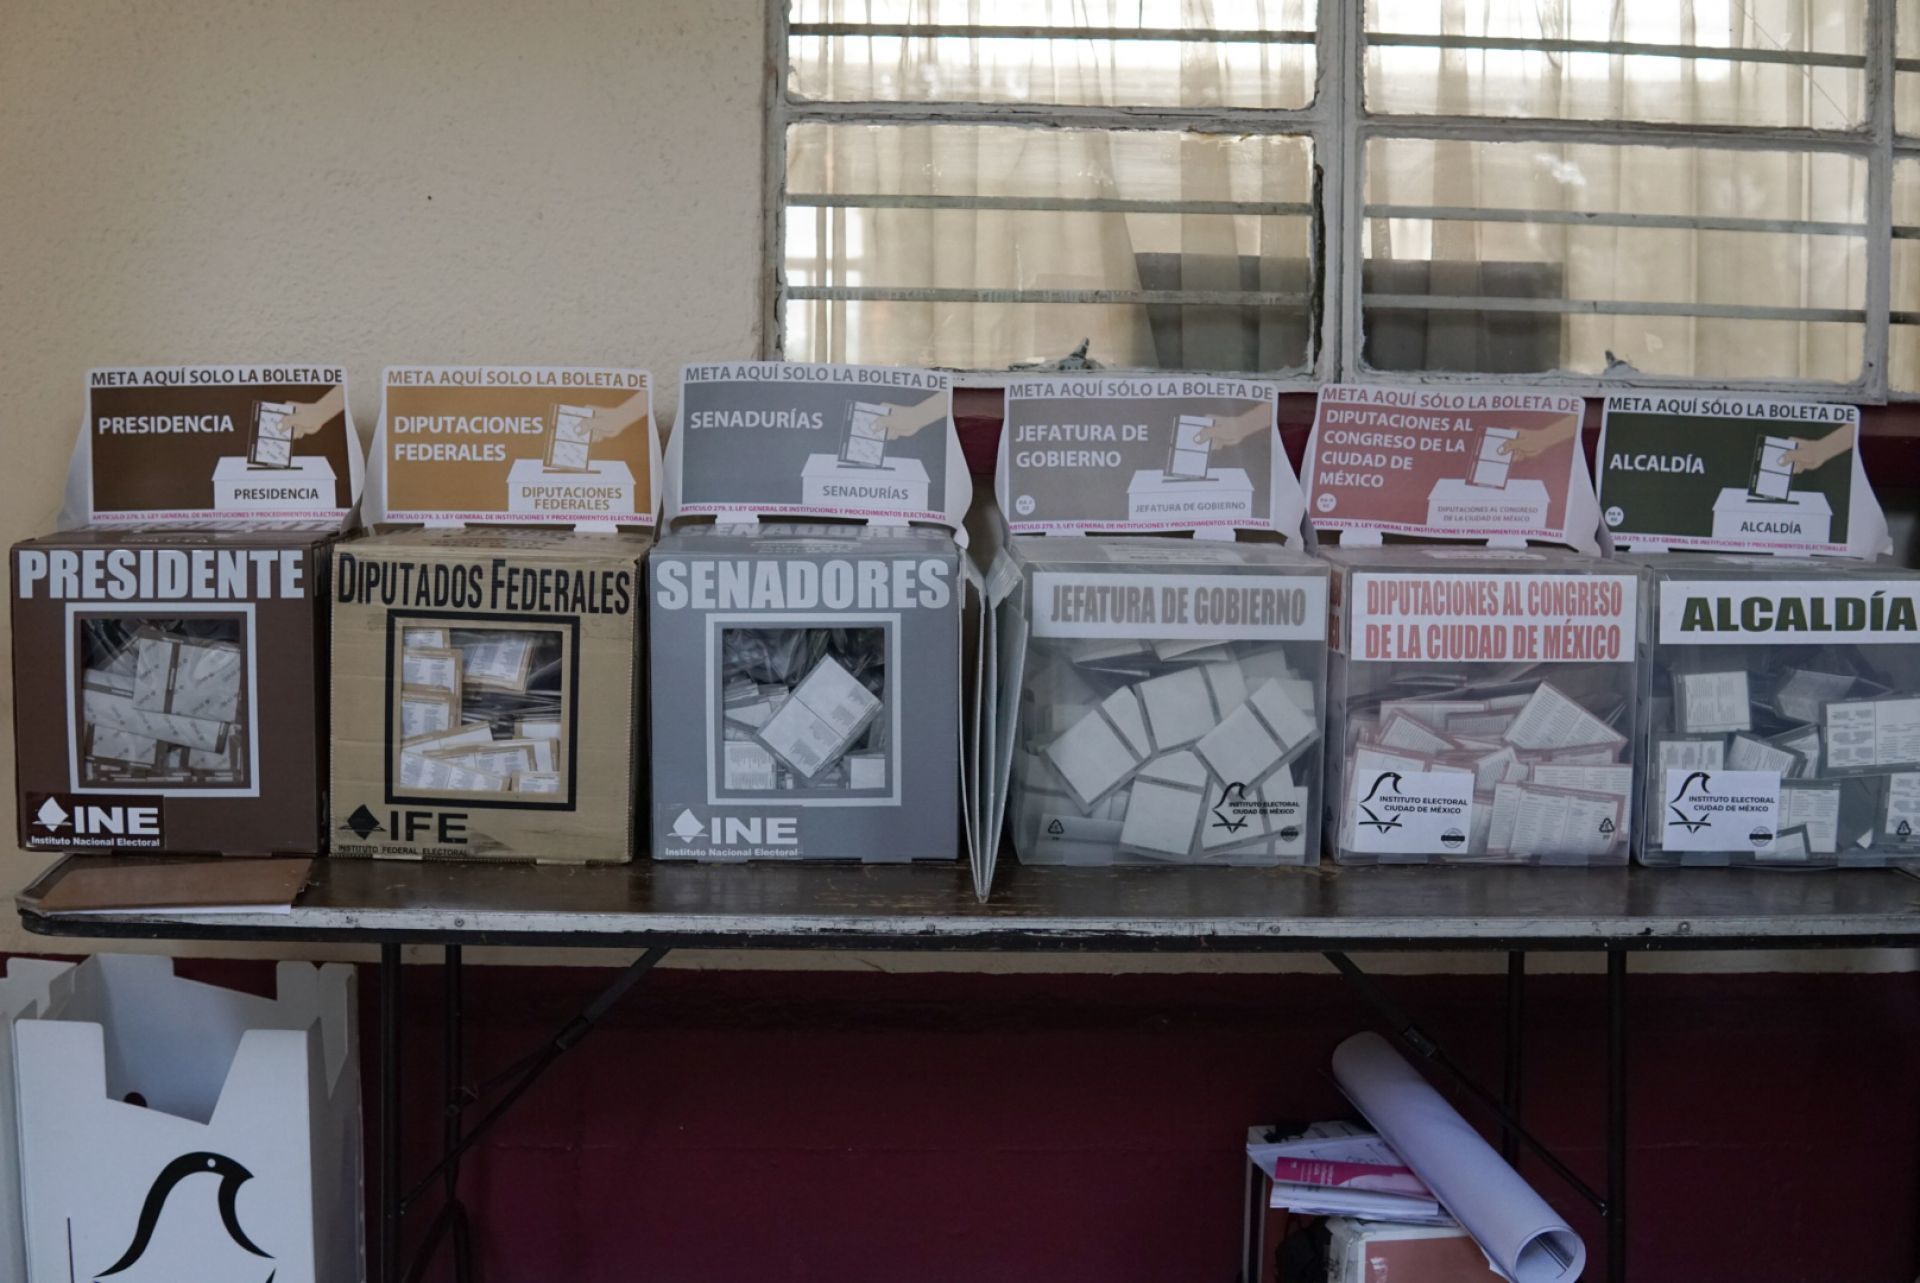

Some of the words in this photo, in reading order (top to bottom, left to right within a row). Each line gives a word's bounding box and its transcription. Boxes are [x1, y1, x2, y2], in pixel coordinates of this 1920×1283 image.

[91, 371, 138, 386] META
[143, 368, 186, 386] AQUÍ
[190, 369, 234, 384] SOLO
[239, 369, 258, 383] LA
[263, 368, 320, 382] BOLETA
[324, 368, 342, 382] DE
[388, 370, 435, 384] META
[439, 368, 483, 386] AQUÍ
[486, 371, 532, 385] SOLO
[536, 372, 557, 386] LA
[562, 372, 624, 387] BOLETA
[627, 374, 648, 388] DE
[686, 366, 731, 382] META
[735, 364, 779, 382] AQUÍ
[783, 366, 828, 382] SOLO
[833, 368, 853, 383] LA
[858, 369, 923, 387] BOLETA
[926, 375, 948, 389] DE
[1009, 384, 1055, 398] META
[1060, 380, 1102, 398] AQUÍ
[1108, 380, 1152, 397] SÓLO
[1157, 382, 1178, 396] LA
[1182, 382, 1247, 398] BOLETA
[1252, 386, 1272, 400] DE
[1322, 387, 1368, 402] META
[1373, 389, 1417, 406] AQUÍ
[1420, 390, 1464, 409] SÓLO
[1468, 395, 1487, 409] LA
[1492, 394, 1552, 410] BOLETA
[1558, 398, 1579, 412] DE
[1608, 397, 1651, 411] META
[1656, 398, 1697, 415] AQUÍ
[1701, 400, 1743, 416] SÓLO
[1747, 403, 1764, 417] LA
[1769, 404, 1829, 420] BOLETA
[1834, 408, 1854, 422] DE
[98, 415, 234, 435] PRESIDENCIA
[394, 416, 544, 434] DIPUTACIONES
[690, 408, 824, 430] SENADURÍAS
[1326, 410, 1450, 431] DIPUTACIONES
[1453, 418, 1474, 432] AL
[1016, 424, 1117, 442] JEFATURA
[1122, 425, 1148, 441] DE
[1323, 430, 1416, 450] CONGRESO
[1420, 437, 1441, 452] DE
[1445, 438, 1466, 452] LA
[394, 444, 506, 462] FEDERALES
[1016, 451, 1122, 468] GOBIERNO
[1320, 451, 1386, 468] CIUDAD
[1390, 456, 1414, 470] DE
[1609, 453, 1704, 474] ALCALDÍA
[1318, 470, 1384, 488] MÉXICO
[234, 488, 319, 500] PRESIDENCIA
[522, 486, 622, 500] DIPUTACIONES
[822, 485, 909, 500] SENADURÍAS
[534, 499, 610, 510] FEDERALES
[1136, 503, 1181, 514] JEFATURA
[1182, 502, 1196, 512] DE
[1197, 502, 1246, 511] GOBIERNO
[1490, 506, 1499, 514] AL
[1500, 506, 1538, 514] CONGRESO
[1456, 514, 1465, 522] LA
[1466, 514, 1492, 522] CIUDAD
[1504, 514, 1530, 522] MÉXICO
[1740, 521, 1802, 534] ALCALDÍA
[18, 550, 304, 599] PRESIDENTE
[338, 552, 483, 609] DIPUTADOS
[490, 558, 631, 615] FEDERALES
[656, 559, 950, 610] SENADORES
[1051, 585, 1156, 624] JEFATURA
[1161, 587, 1188, 624] DE
[1194, 586, 1306, 626] GOBIERNO
[1366, 580, 1498, 616] DIPUTACIONES
[1502, 581, 1524, 616] AL
[1528, 580, 1622, 617] CONGRESO
[1680, 590, 1918, 632] ALCALDÍA
[1365, 624, 1392, 659] DE
[1396, 624, 1422, 660] LA
[1426, 624, 1508, 660] CIUDAD
[1512, 624, 1538, 660] DE
[1542, 618, 1620, 660] MÉXICO
[1379, 796, 1421, 804] INSTITUTO
[1422, 796, 1468, 805] ELECTORAL
[1384, 804, 1415, 812] CIUDAD
[1430, 804, 1461, 814] MÉXICO
[1694, 804, 1723, 812] CIUDAD
[1738, 804, 1769, 812] MÉXICO
[1731, 796, 1776, 804] ELECTORAL
[74, 806, 160, 834] INE
[390, 810, 468, 844] IFE
[711, 817, 798, 844] INE
[31, 836, 71, 846] Instituto
[73, 836, 115, 846] Nacional
[117, 837, 160, 847] Electoral
[338, 844, 378, 854] INSTITUTO
[382, 846, 418, 855] FEDERAL
[665, 848, 706, 856] Instituto
[708, 848, 752, 856] Nacional
[754, 848, 798, 856] Electoral
